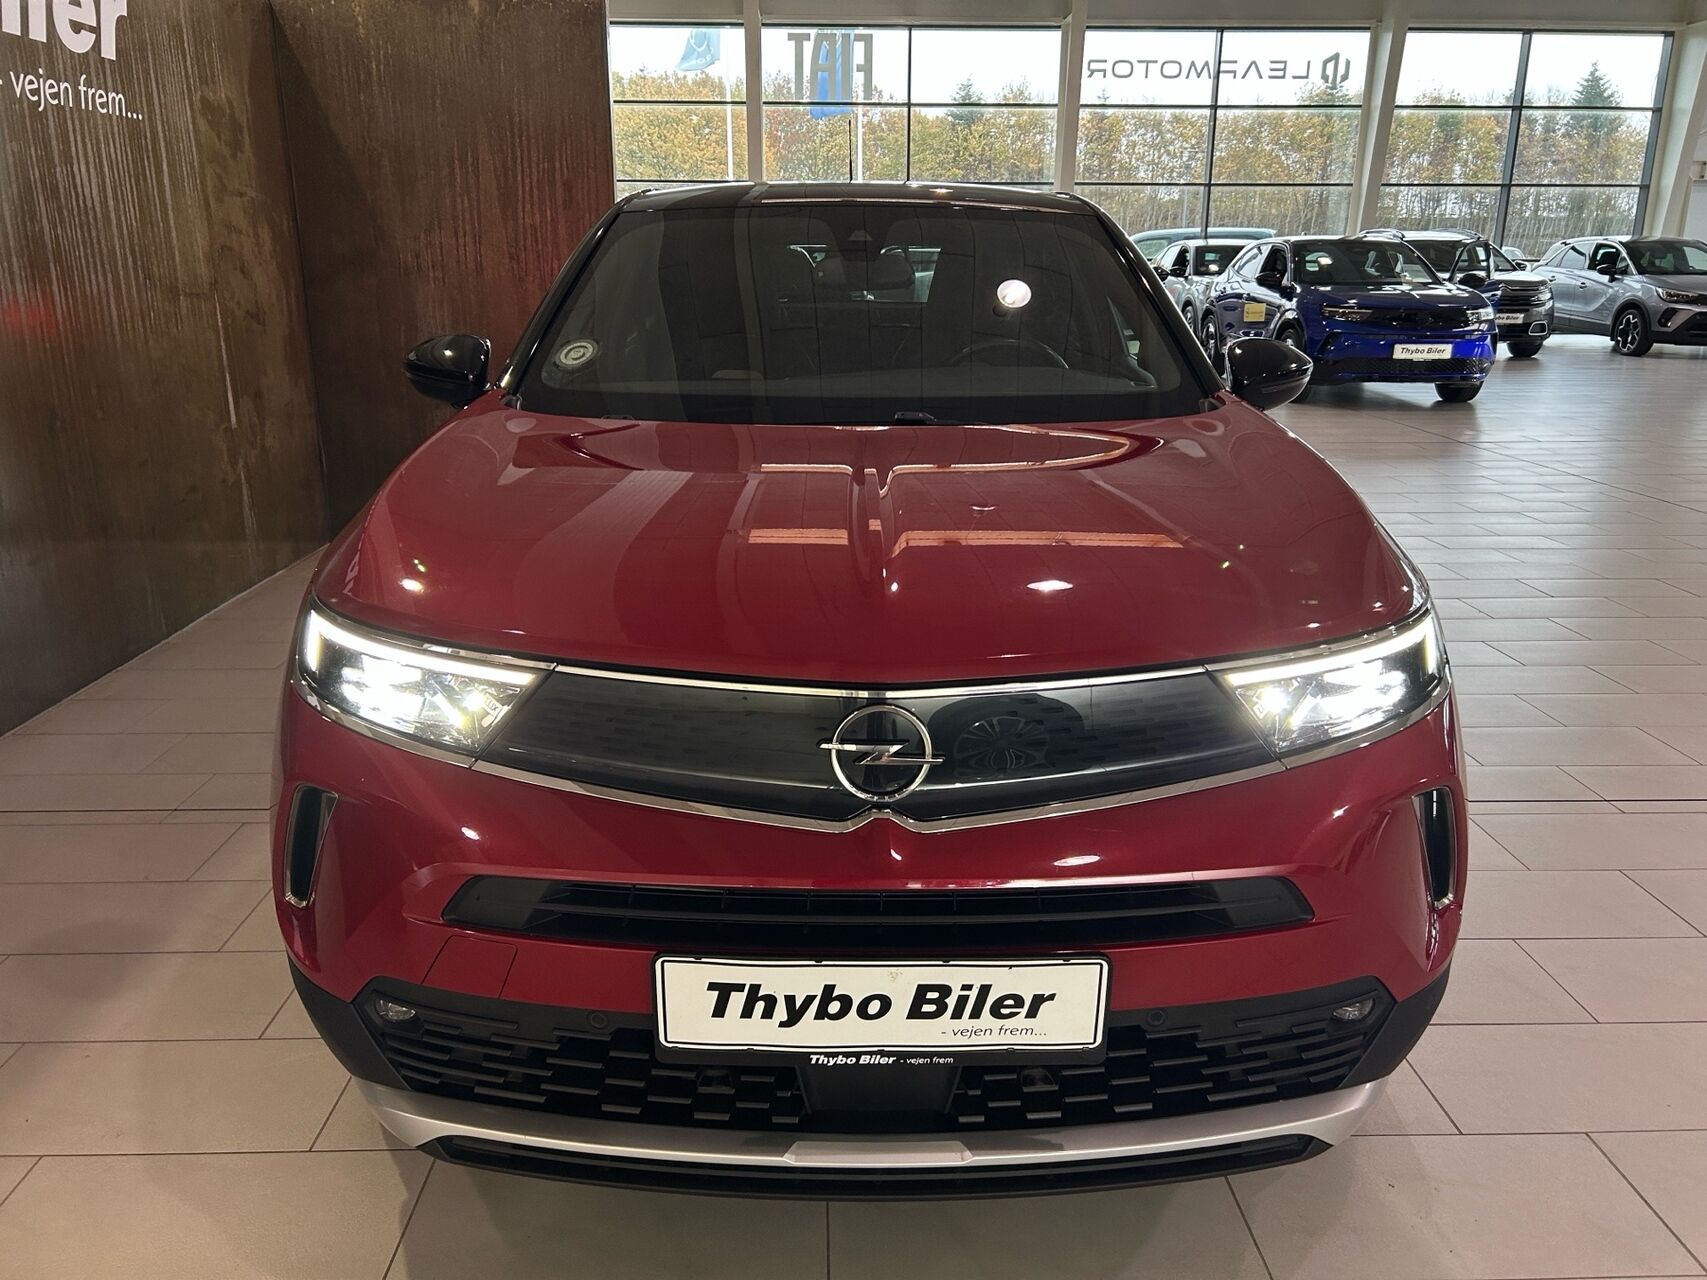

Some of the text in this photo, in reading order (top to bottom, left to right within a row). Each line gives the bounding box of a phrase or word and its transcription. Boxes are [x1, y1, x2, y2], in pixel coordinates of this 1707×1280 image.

[9, 68, 143, 120] vejen frem...
[1400, 347, 1425, 355] Thybo
[706, 981, 1057, 1028] Thybo Biler
[952, 1025, 993, 1039] vejen
[998, 1023, 1047, 1036] frem...
[809, 1054, 856, 1066] Thybo
[859, 1054, 897, 1065] Biler
[906, 1056, 931, 1065] vejen
[932, 1056, 954, 1064] frem
